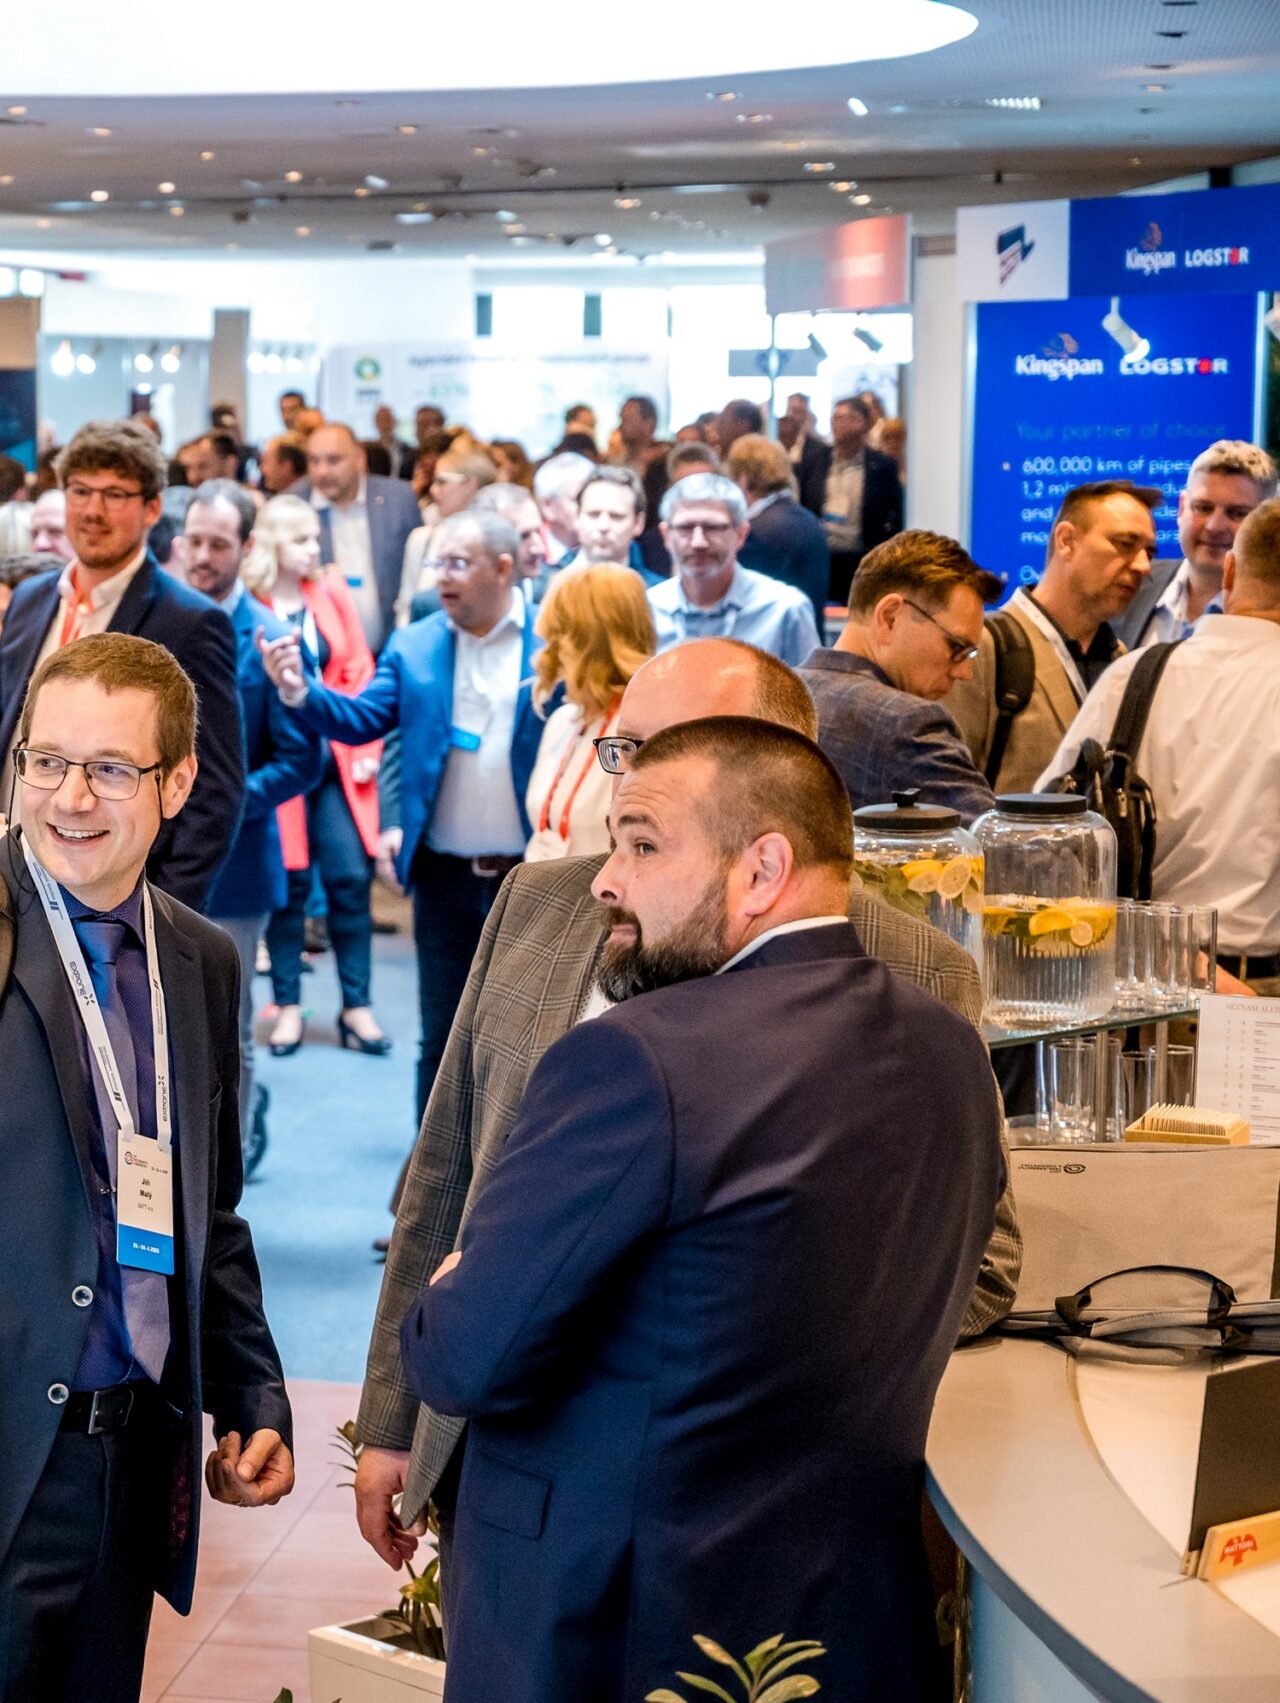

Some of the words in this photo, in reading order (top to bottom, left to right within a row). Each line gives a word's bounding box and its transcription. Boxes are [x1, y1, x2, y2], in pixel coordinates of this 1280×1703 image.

[1125, 248, 1175, 275] Kingspan
[1016, 354, 1103, 380] Kingspan
[1063, 422, 1132, 441] partner
[1140, 419, 1160, 438] of
[1128, 456, 1144, 472] of
[1022, 506, 1053, 521] and
